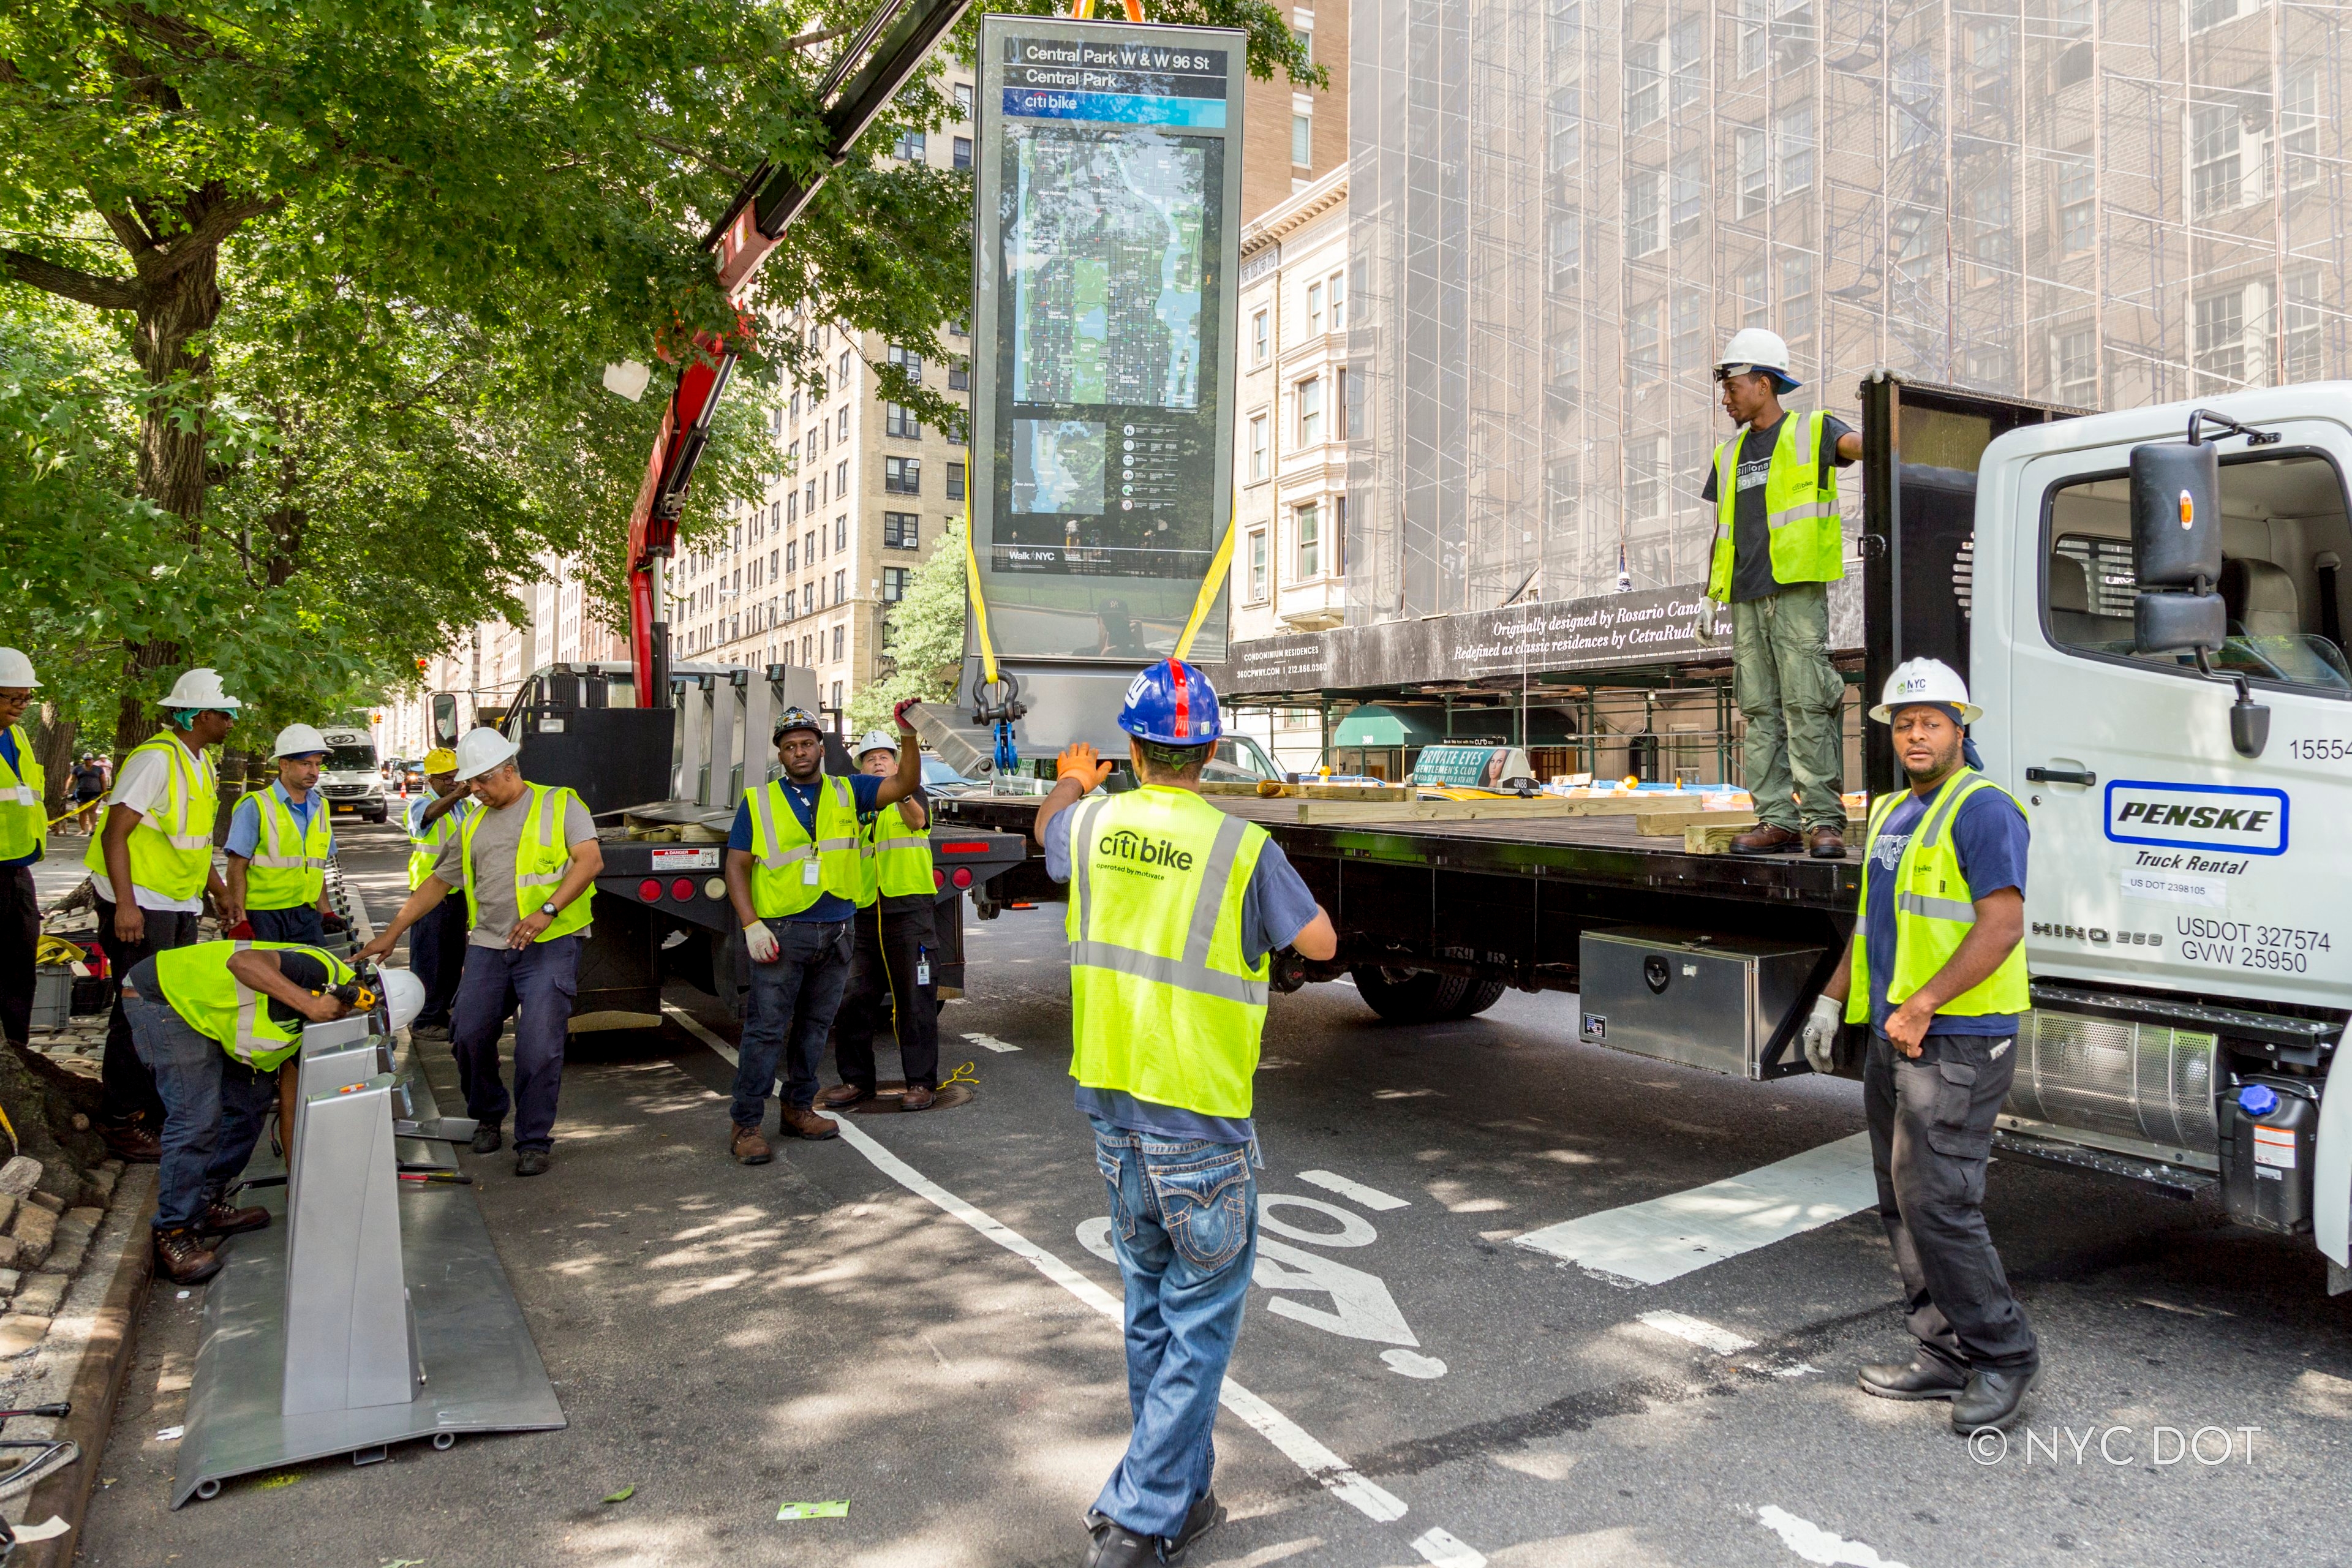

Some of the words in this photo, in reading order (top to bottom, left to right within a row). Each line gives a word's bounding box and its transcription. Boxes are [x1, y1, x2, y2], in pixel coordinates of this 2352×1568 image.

[1027, 46, 1079, 62] Central
[1084, 50, 1118, 64] Park
[1121, 52, 1136, 65] W
[1140, 53, 1150, 66] &
[1154, 54, 1169, 67] W
[1172, 55, 1190, 69] 96
[1194, 56, 1209, 70] St
[1026, 69, 1079, 85] Central
[1084, 72, 1117, 87] Park
[1009, 551, 1030, 560] Walk
[1493, 617, 1547, 638] Originally
[1548, 611, 1597, 632] designed
[1600, 609, 1614, 628] by
[1616, 603, 1664, 624] Rosario
[1244, 649, 1284, 662] CONDOMINIUM
[1285, 646, 1319, 657] RESIDENCES
[1453, 642, 1500, 662] Redefined
[1502, 646, 1513, 655] as
[1515, 638, 1550, 654] classic
[1551, 634, 1608, 651] residences
[1611, 631, 1626, 649] by
[1237, 667, 1280, 679] 360CPWNY.COM
[1288, 663, 1327, 674] 212.866.0360
[1907, 679, 1926, 688] NYC
[1362, 735, 1373, 744] 360
[1419, 750, 1460, 764] PRIVATE
[1458, 752, 1484, 765] EYES
[1415, 764, 1459, 775] GENTLEMEN'S
[1460, 766, 1477, 775] CLUB
[1513, 778, 1527, 788] 4N88
[2117, 801, 2273, 833] PENSKE
[1096, 863, 1126, 873] operated
[1126, 867, 1134, 876] by
[1135, 869, 1164, 881] motivate
[2135, 851, 2184, 869] Truck
[2185, 856, 2249, 875] Rental
[2130, 878, 2143, 888] US
[2146, 881, 2165, 890] DOT
[2168, 883, 2205, 895] 2398105
[2032, 921, 2110, 943] HINO
[2116, 931, 2163, 947] 268
[2177, 916, 2251, 943] USDOT
[2256, 925, 2331, 952] 327574
[2182, 940, 2234, 964] GVW
[2241, 947, 2307, 973] 25950
